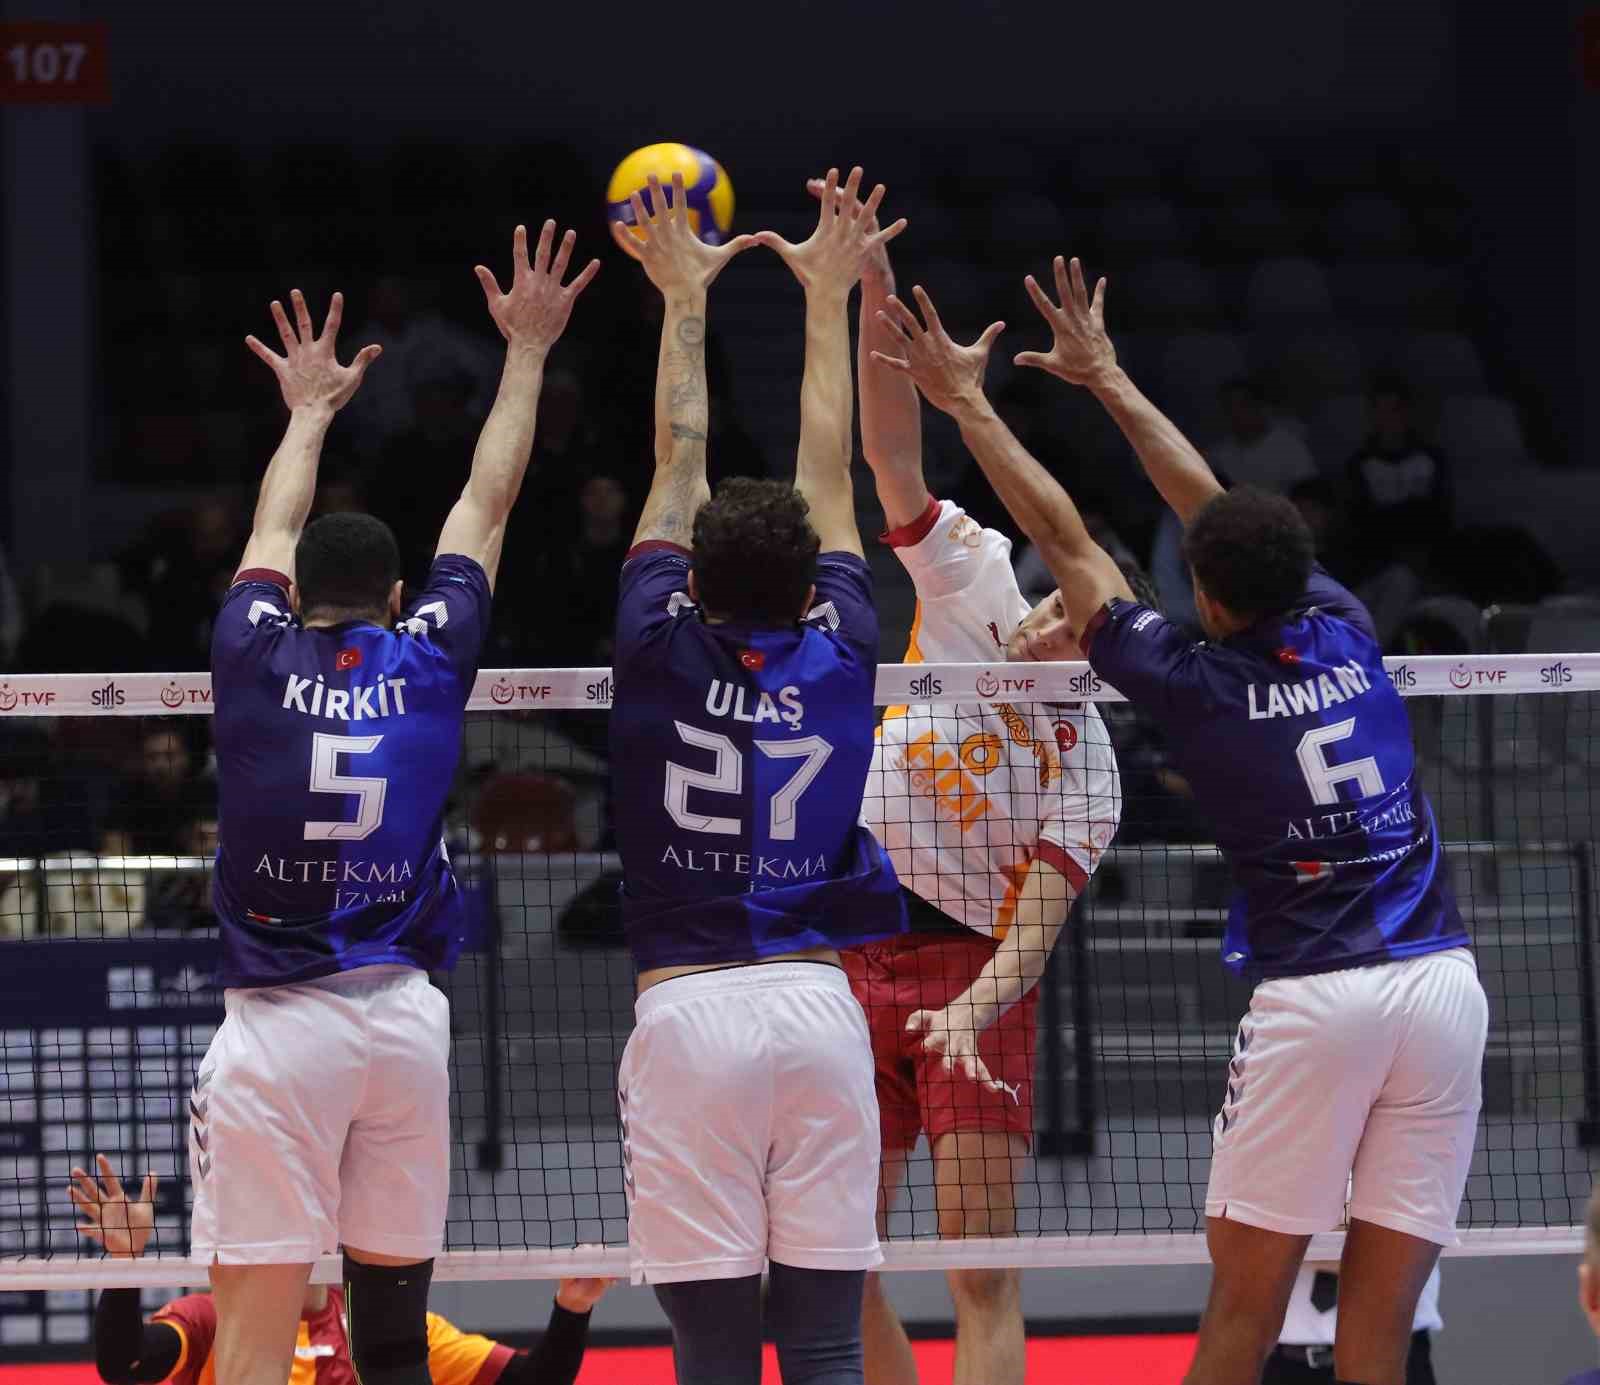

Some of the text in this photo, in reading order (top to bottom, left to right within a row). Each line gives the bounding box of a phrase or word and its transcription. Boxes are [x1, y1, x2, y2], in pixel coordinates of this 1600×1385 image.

[8, 43, 87, 83] 107
[518, 686, 552, 700] TVF
[1002, 678, 1035, 693] TVF
[1248, 659, 1372, 720] LAWANI
[1475, 670, 1507, 684] TVF
[21, 692, 56, 706] TVF
[188, 689, 211, 703] TV
[282, 673, 407, 720] KİRKİT
[705, 679, 803, 731] ULAŞ
[1295, 716, 1386, 805] 6
[304, 732, 388, 840] 5
[664, 720, 834, 841] 27
[254, 853, 412, 883] ALTEKMA
[661, 845, 827, 879] ALTEKMA
